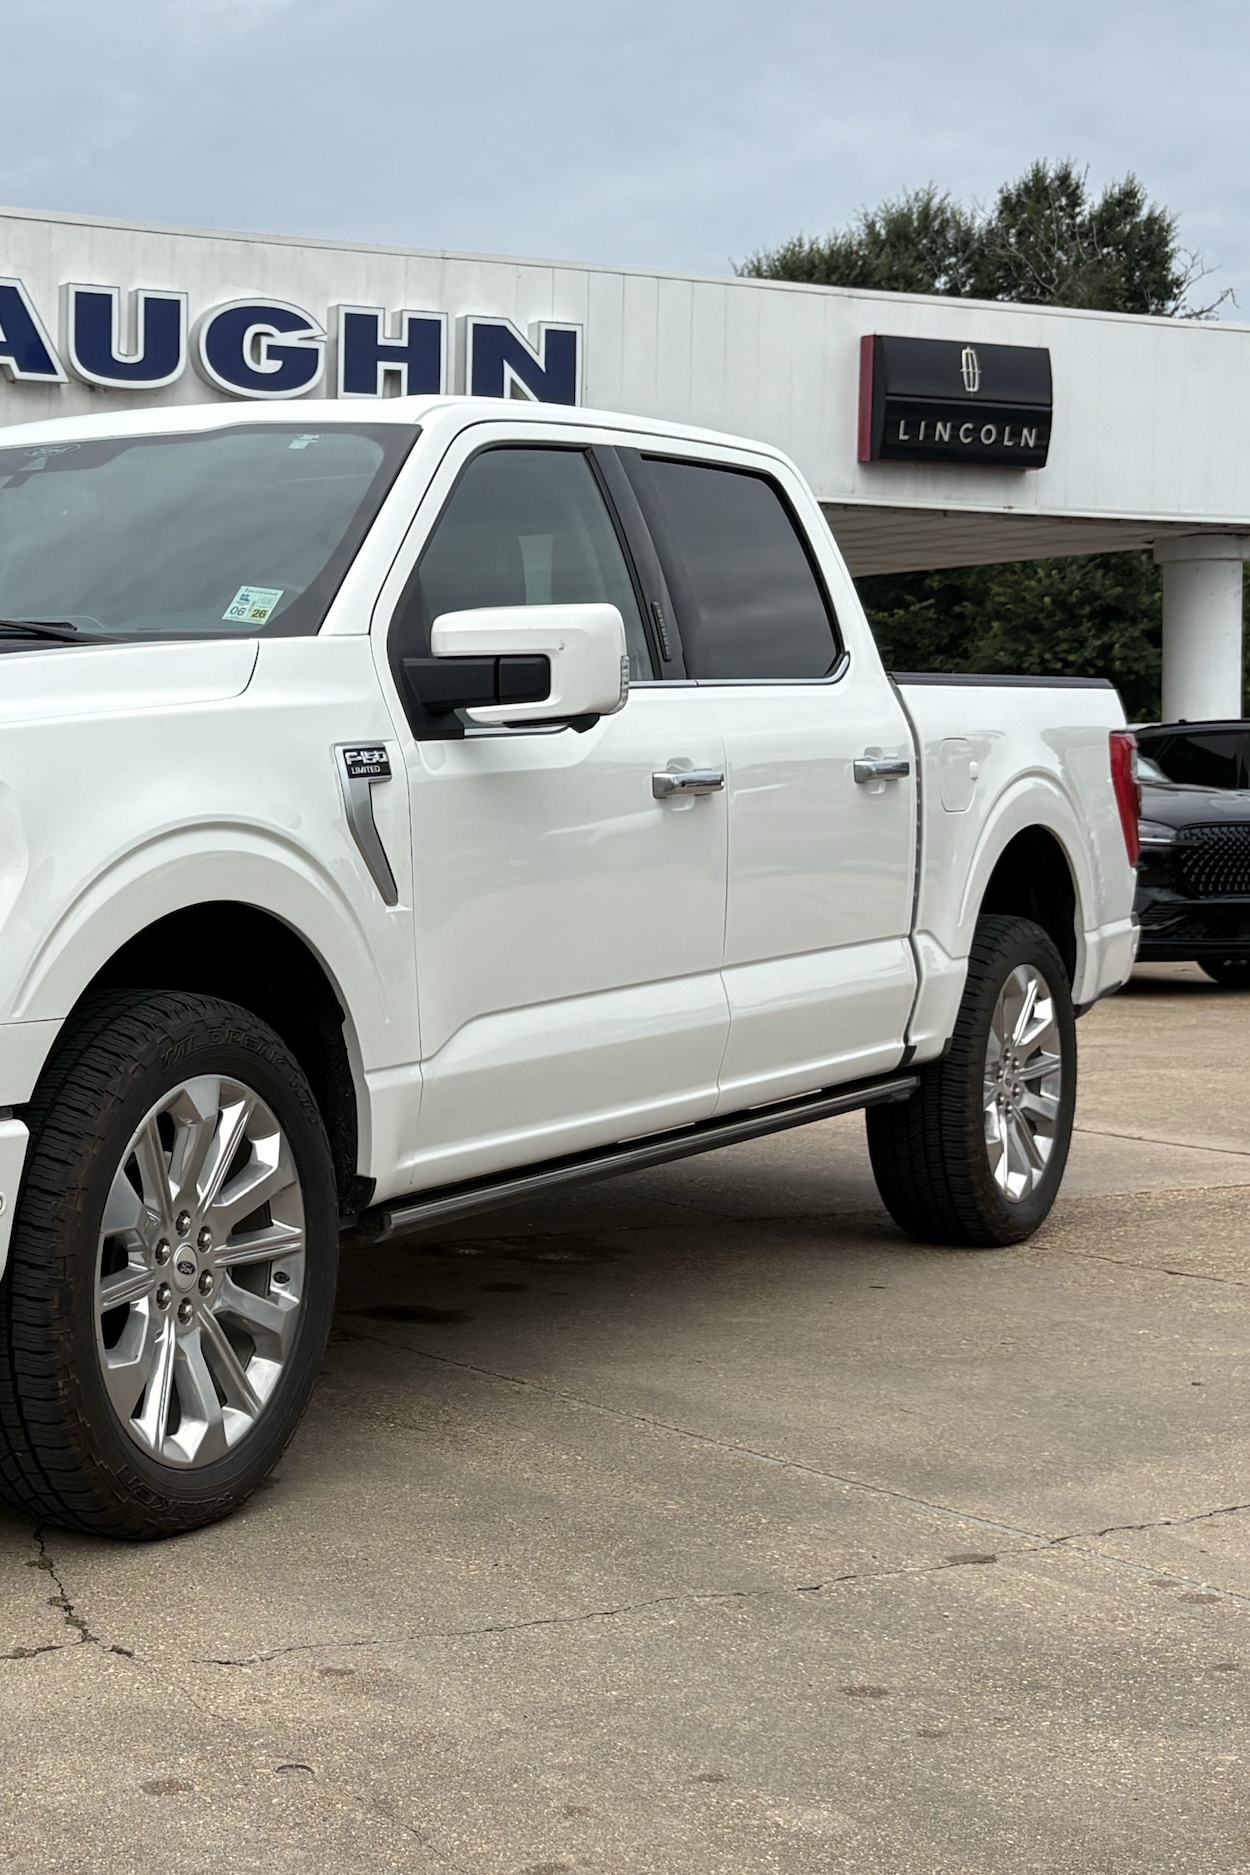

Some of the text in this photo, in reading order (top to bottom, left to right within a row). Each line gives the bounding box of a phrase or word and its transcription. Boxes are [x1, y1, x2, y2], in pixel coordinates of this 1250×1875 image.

[899, 419, 1037, 448] LINCOLN
[230, 606, 267, 618] 06 26
[351, 765, 381, 775] LIMITED
